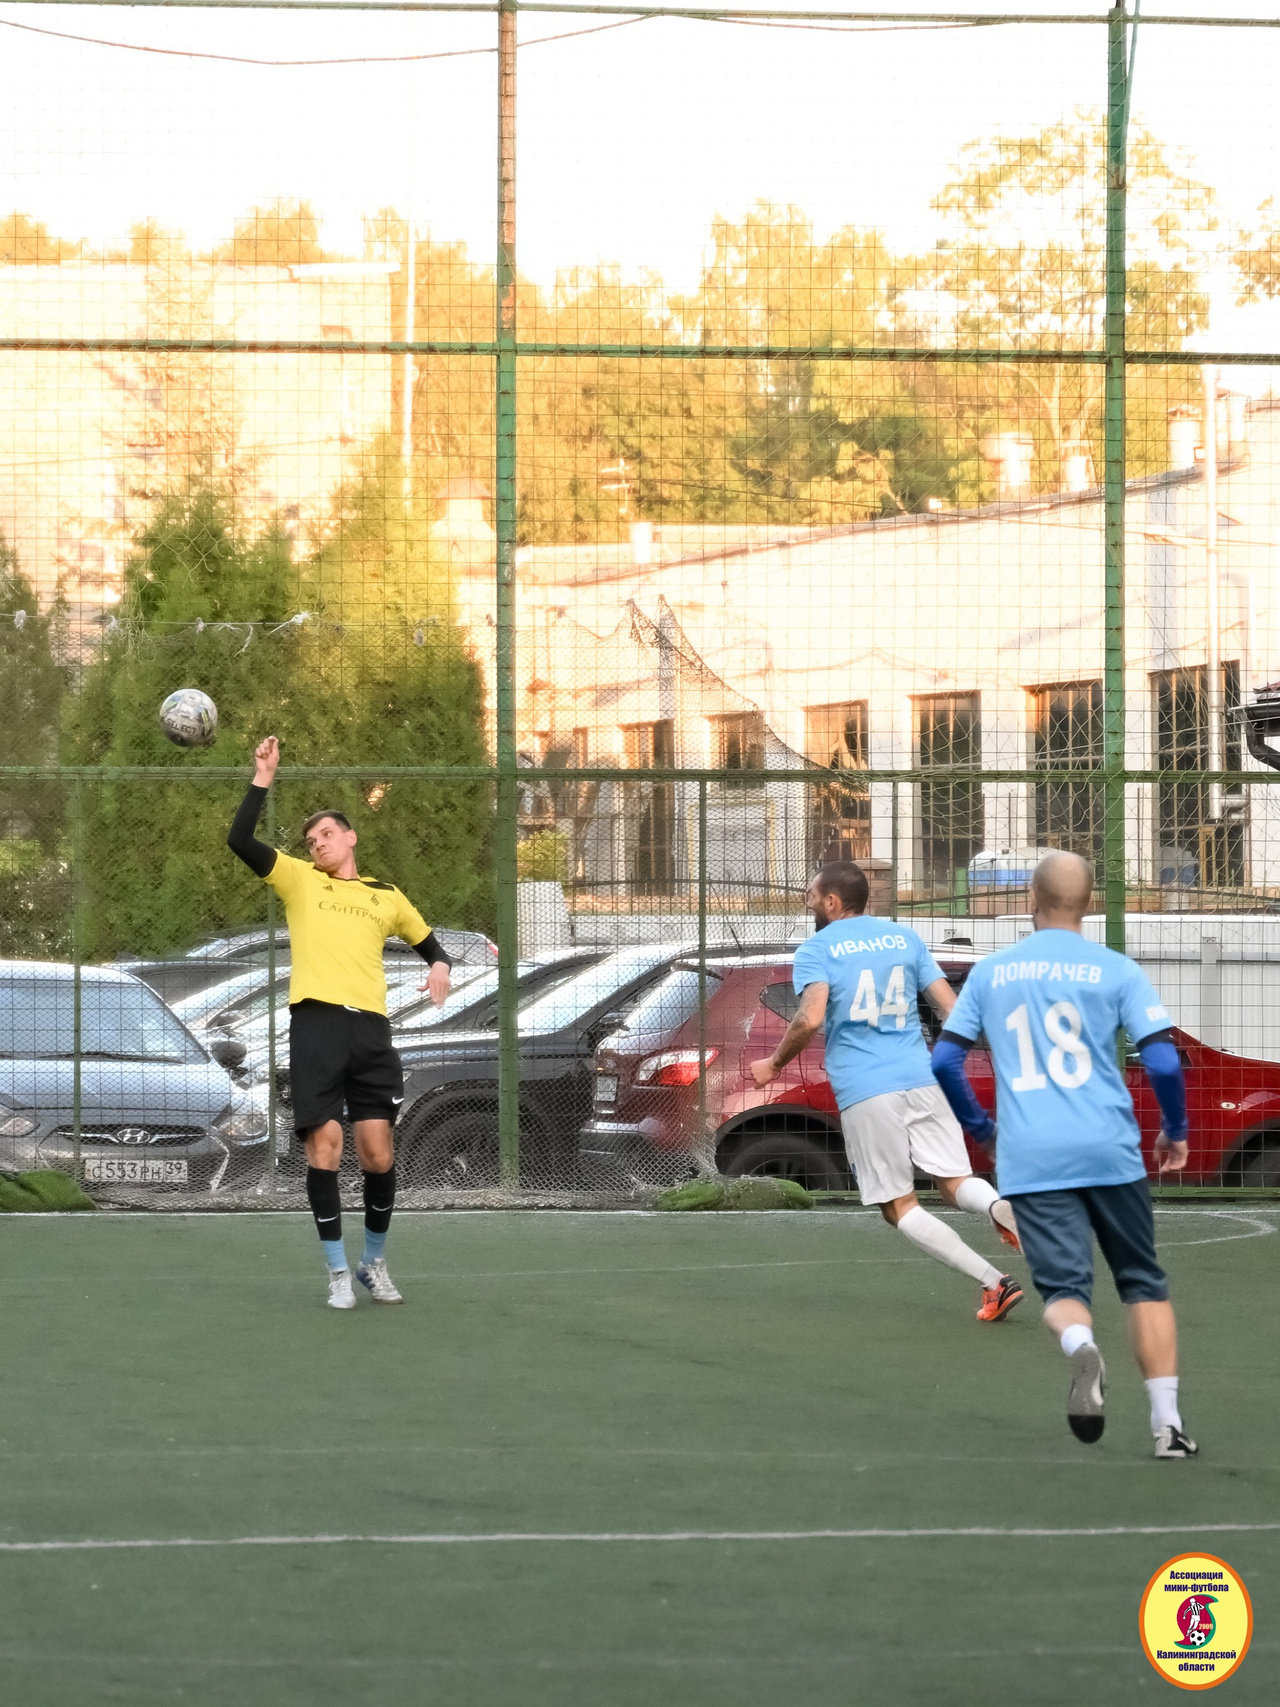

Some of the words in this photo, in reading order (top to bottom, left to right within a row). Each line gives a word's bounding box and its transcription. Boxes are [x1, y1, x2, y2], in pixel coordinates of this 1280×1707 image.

[166, 718, 197, 734] SELECT
[830, 934, 907, 957] ИВАНОВ
[992, 962, 1102, 988] ДОМРАЧЕВ
[849, 965, 909, 1029] 44
[1006, 1001, 1092, 1092] 18
